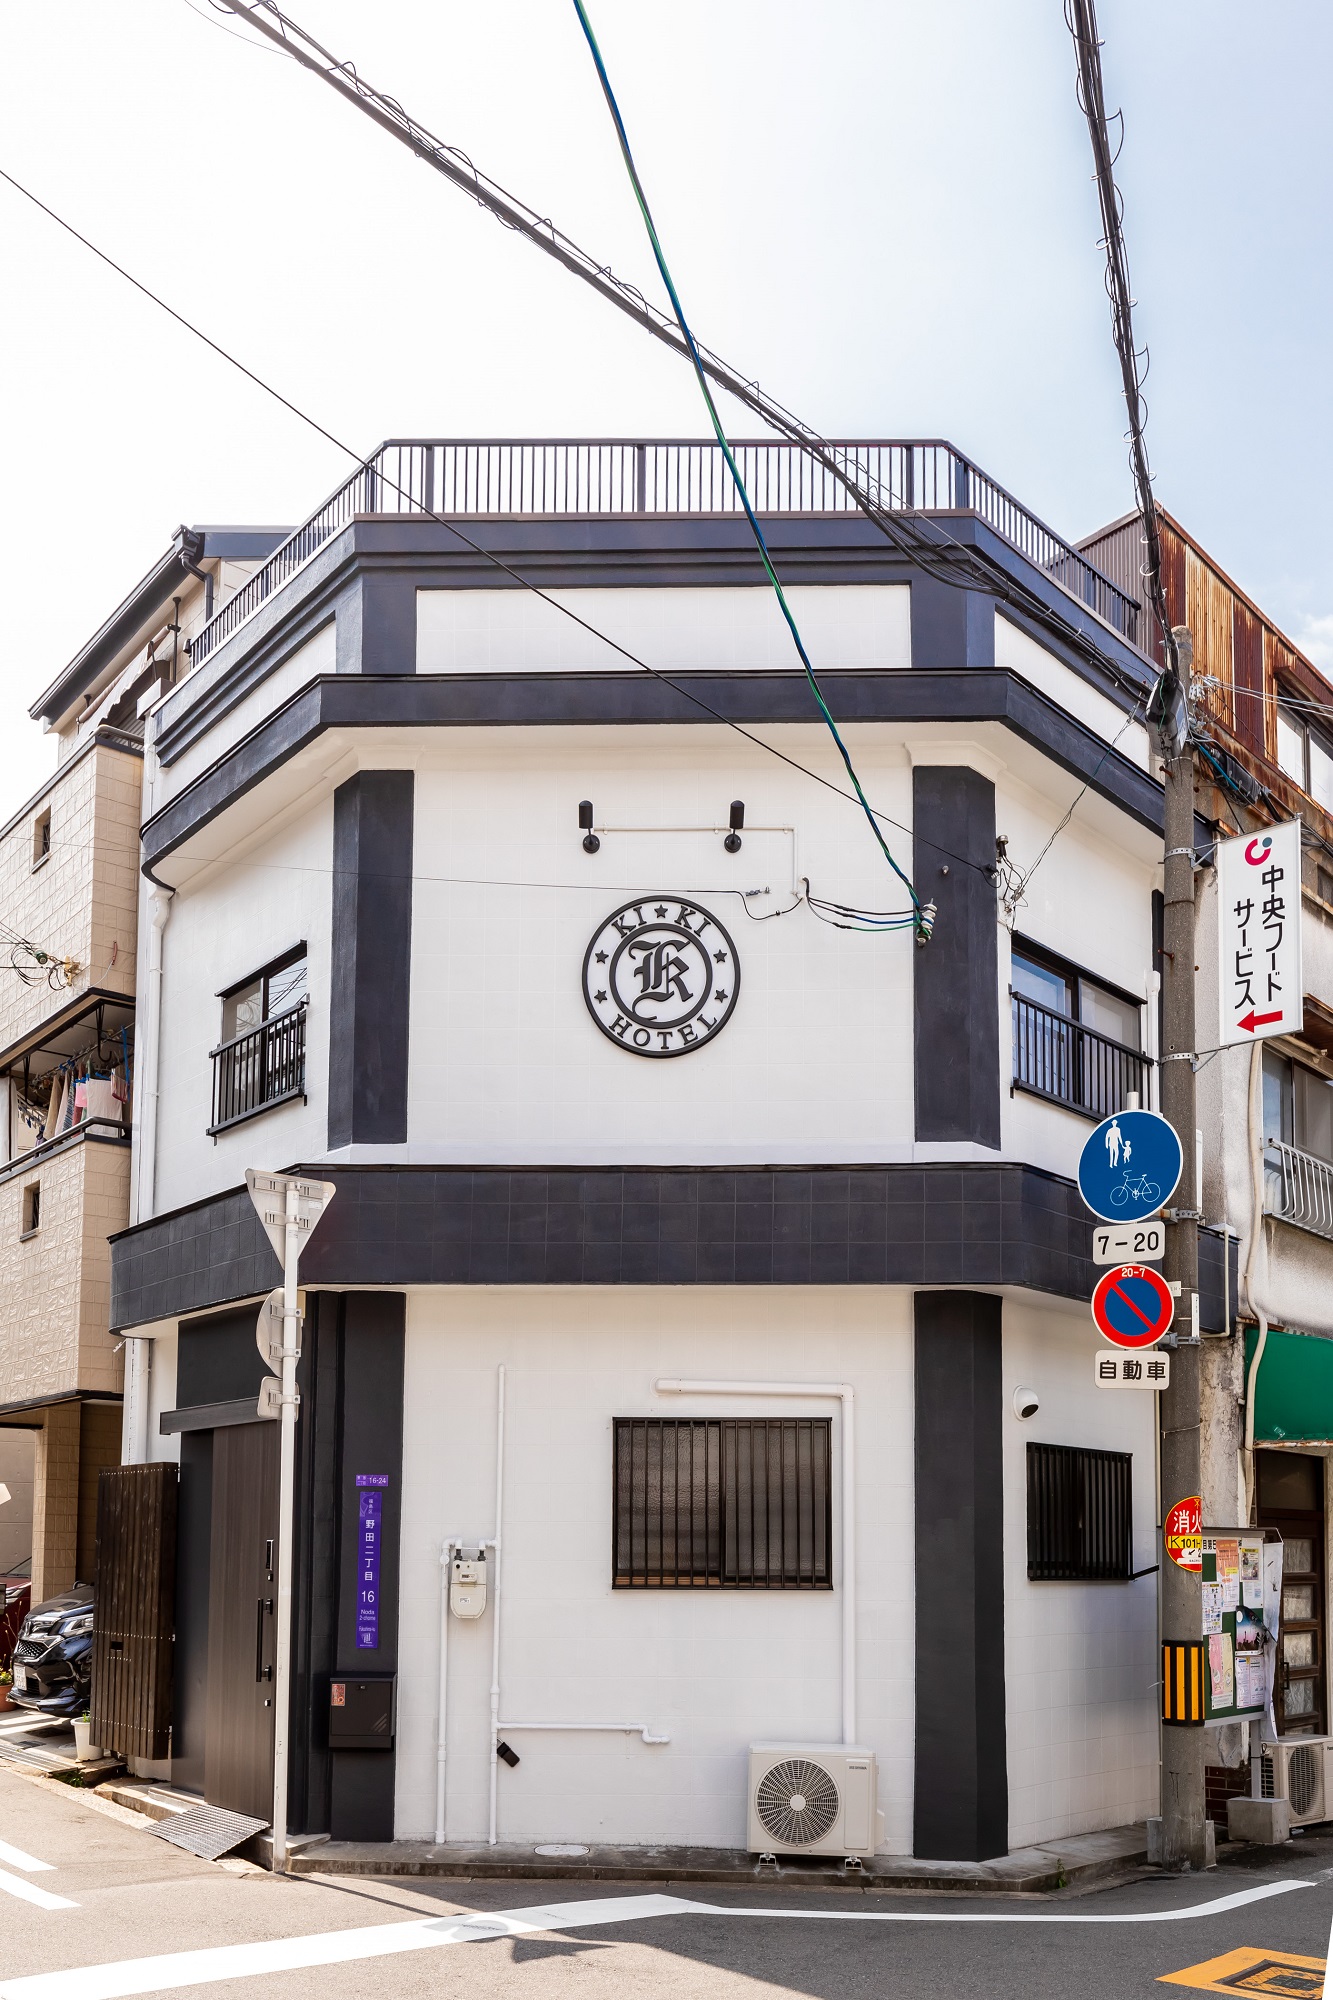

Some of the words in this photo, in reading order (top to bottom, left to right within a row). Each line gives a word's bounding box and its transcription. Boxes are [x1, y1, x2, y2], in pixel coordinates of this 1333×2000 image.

[1262, 864, 1286, 1002] 中央フード
[1233, 898, 1256, 1010] サービス
[609, 1013, 717, 1050] HOTEL
[1098, 1231, 1159, 1255] 7-20
[1121, 1267, 1146, 1278] 20-7
[1100, 1359, 1166, 1381] 自動車
[365, 1519, 375, 1581] 野田二丁目
[361, 1590, 375, 1603] 16
